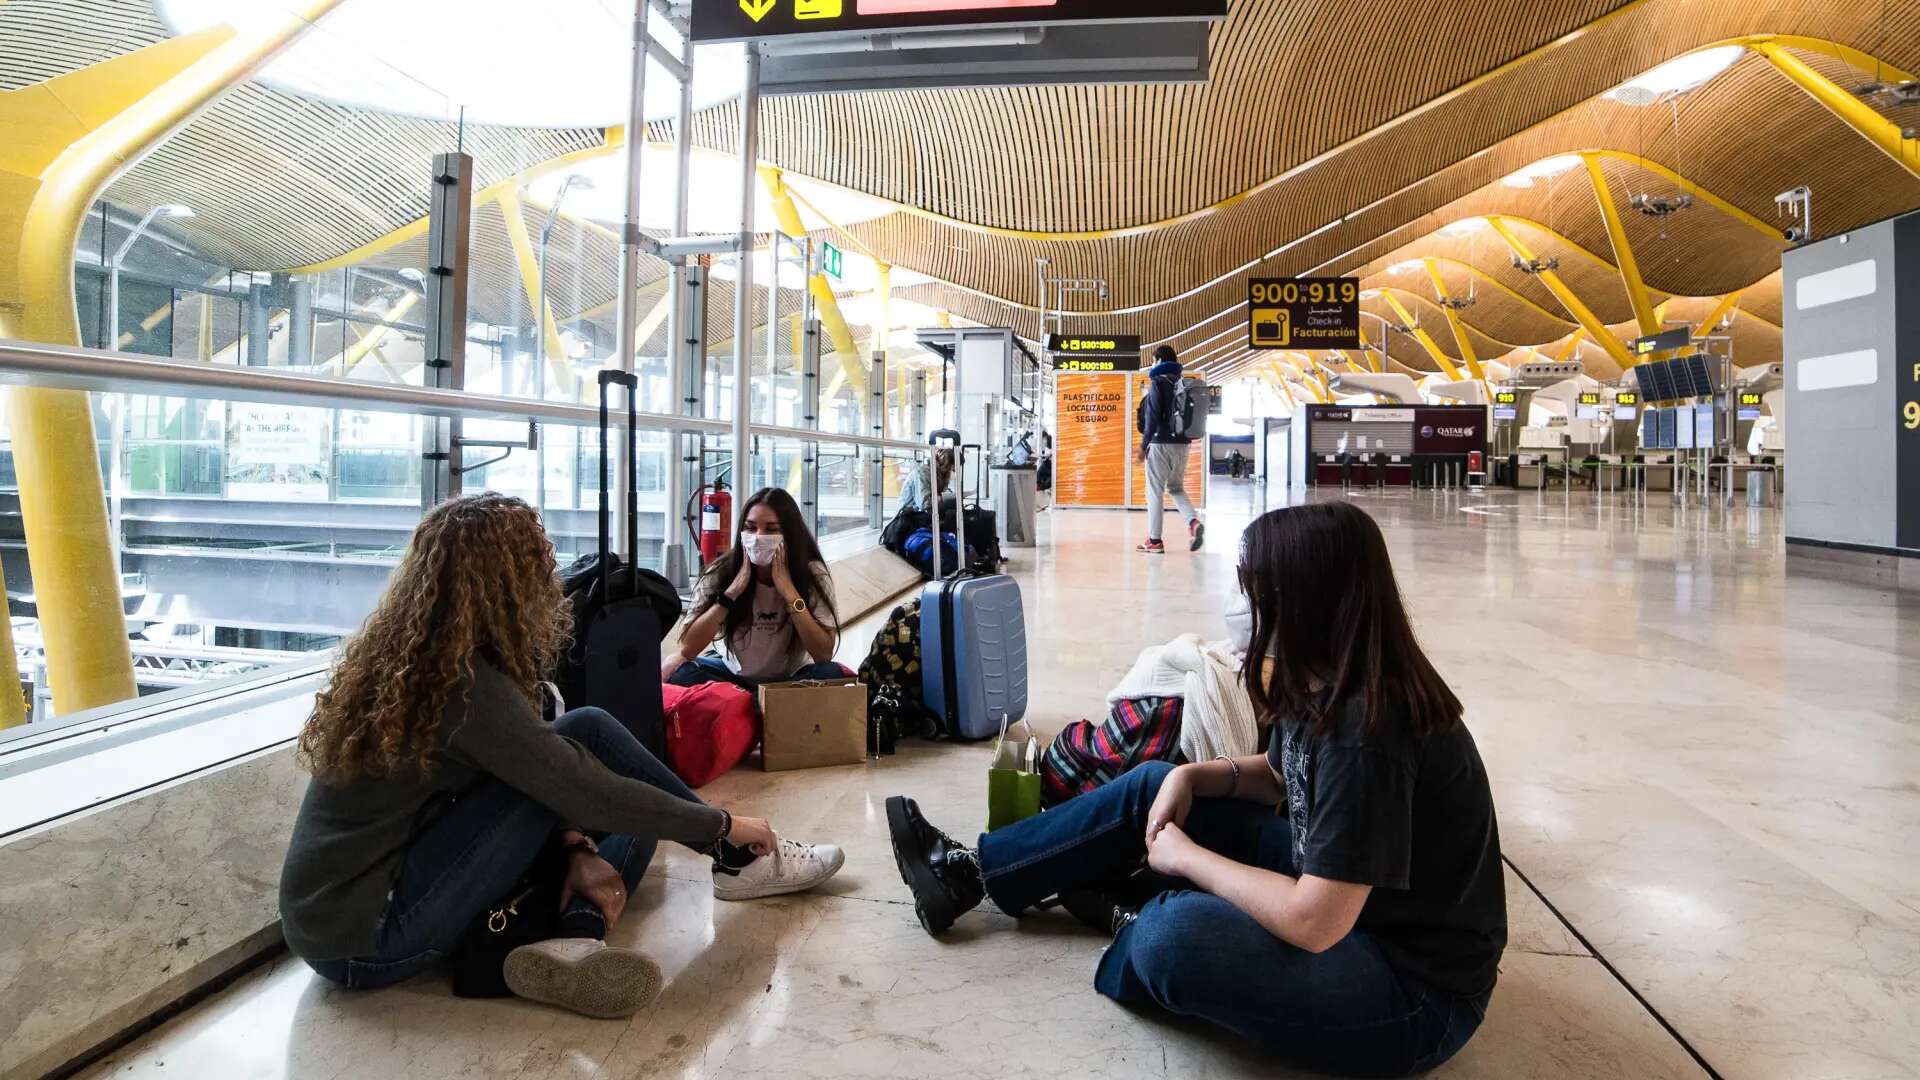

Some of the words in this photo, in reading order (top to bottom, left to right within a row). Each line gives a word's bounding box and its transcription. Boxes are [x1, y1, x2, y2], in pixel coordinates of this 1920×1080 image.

[1251, 283, 1298, 303] 900
[1309, 283, 1356, 303] 919
[1293, 328, 1356, 337] Facturación
[1063, 393, 1121, 401] PLASTIFICADO
[1498, 394, 1514, 402] 910
[1582, 395, 1596, 403] 911
[1618, 394, 1635, 403] 912
[1066, 404, 1117, 412] LOCALIZADOR
[1075, 415, 1109, 423] SEGURO
[1437, 427, 1463, 435] QATAR
